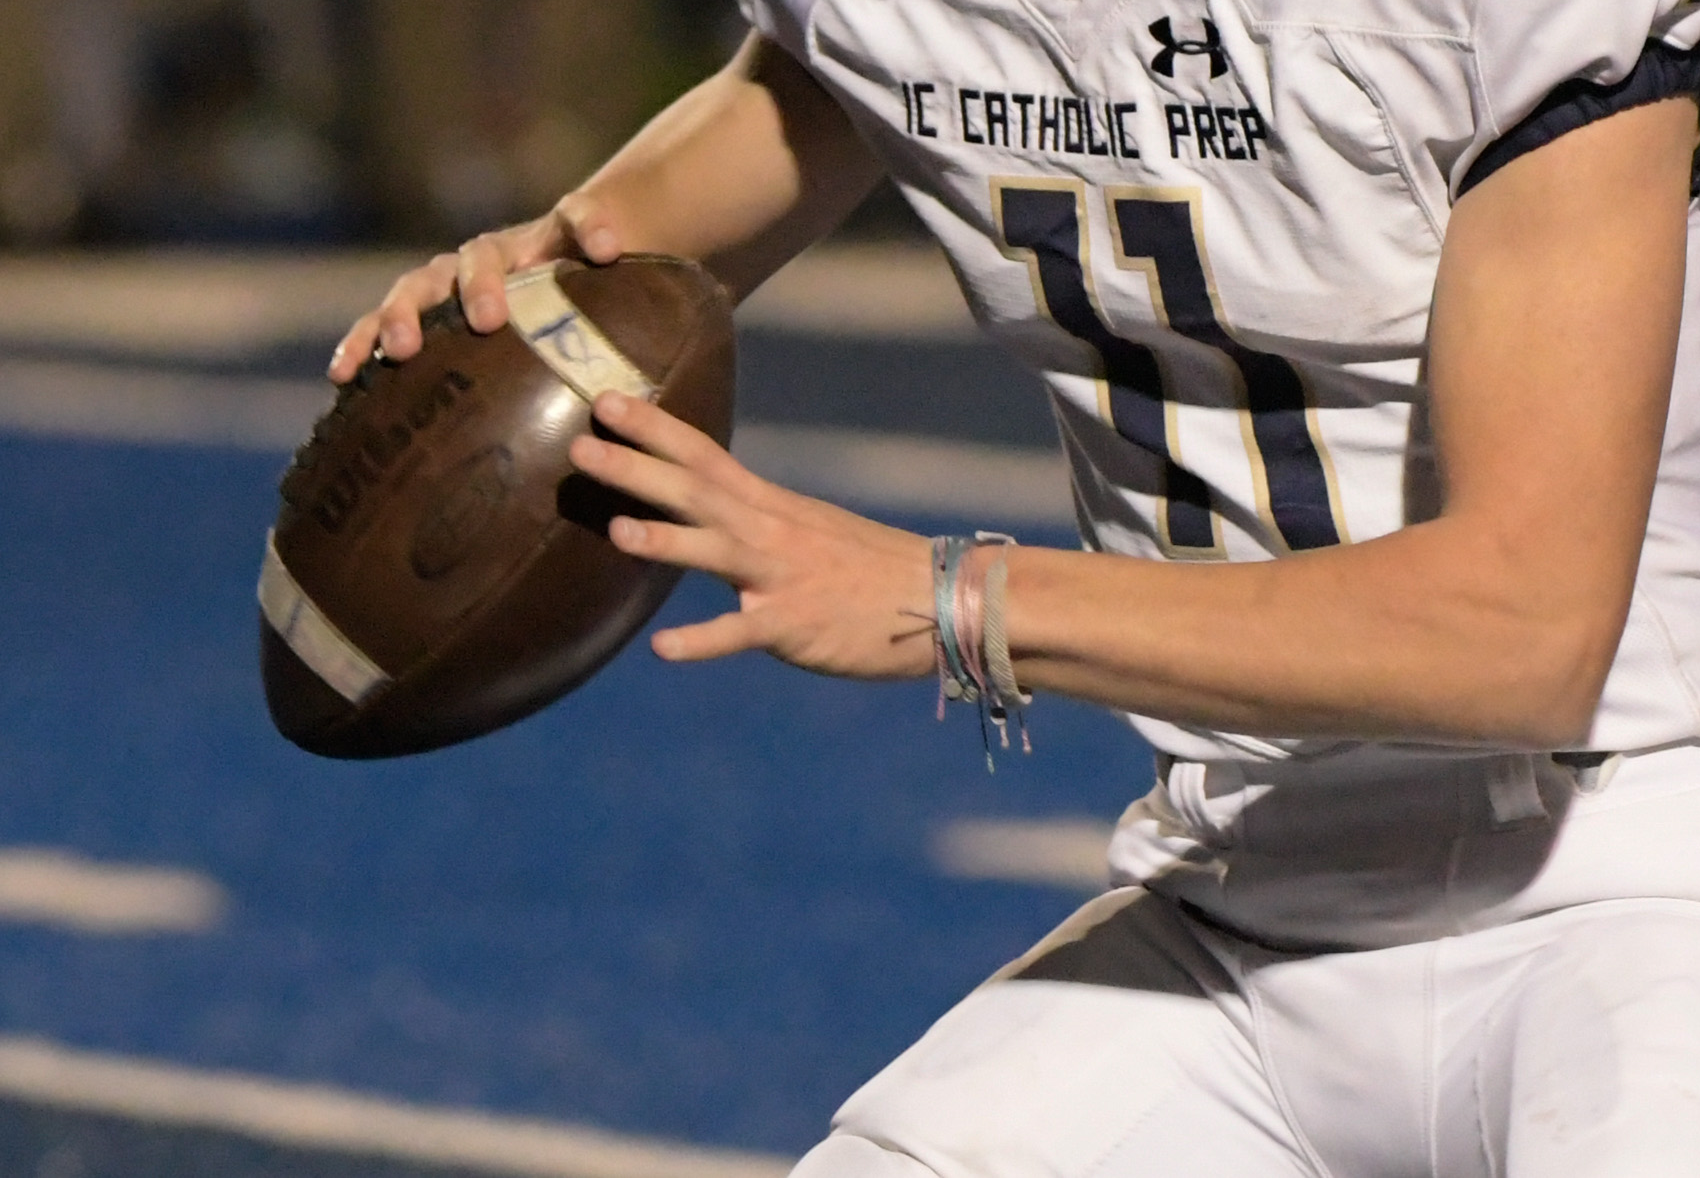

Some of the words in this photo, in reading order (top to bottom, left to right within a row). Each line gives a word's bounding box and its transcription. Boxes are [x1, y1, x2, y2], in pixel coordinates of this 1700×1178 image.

[902, 82, 937, 138] IC
[959, 88, 1140, 159] CATHOLIC
[1164, 104, 1267, 160] PREP
[990, 175, 1352, 563] 11
